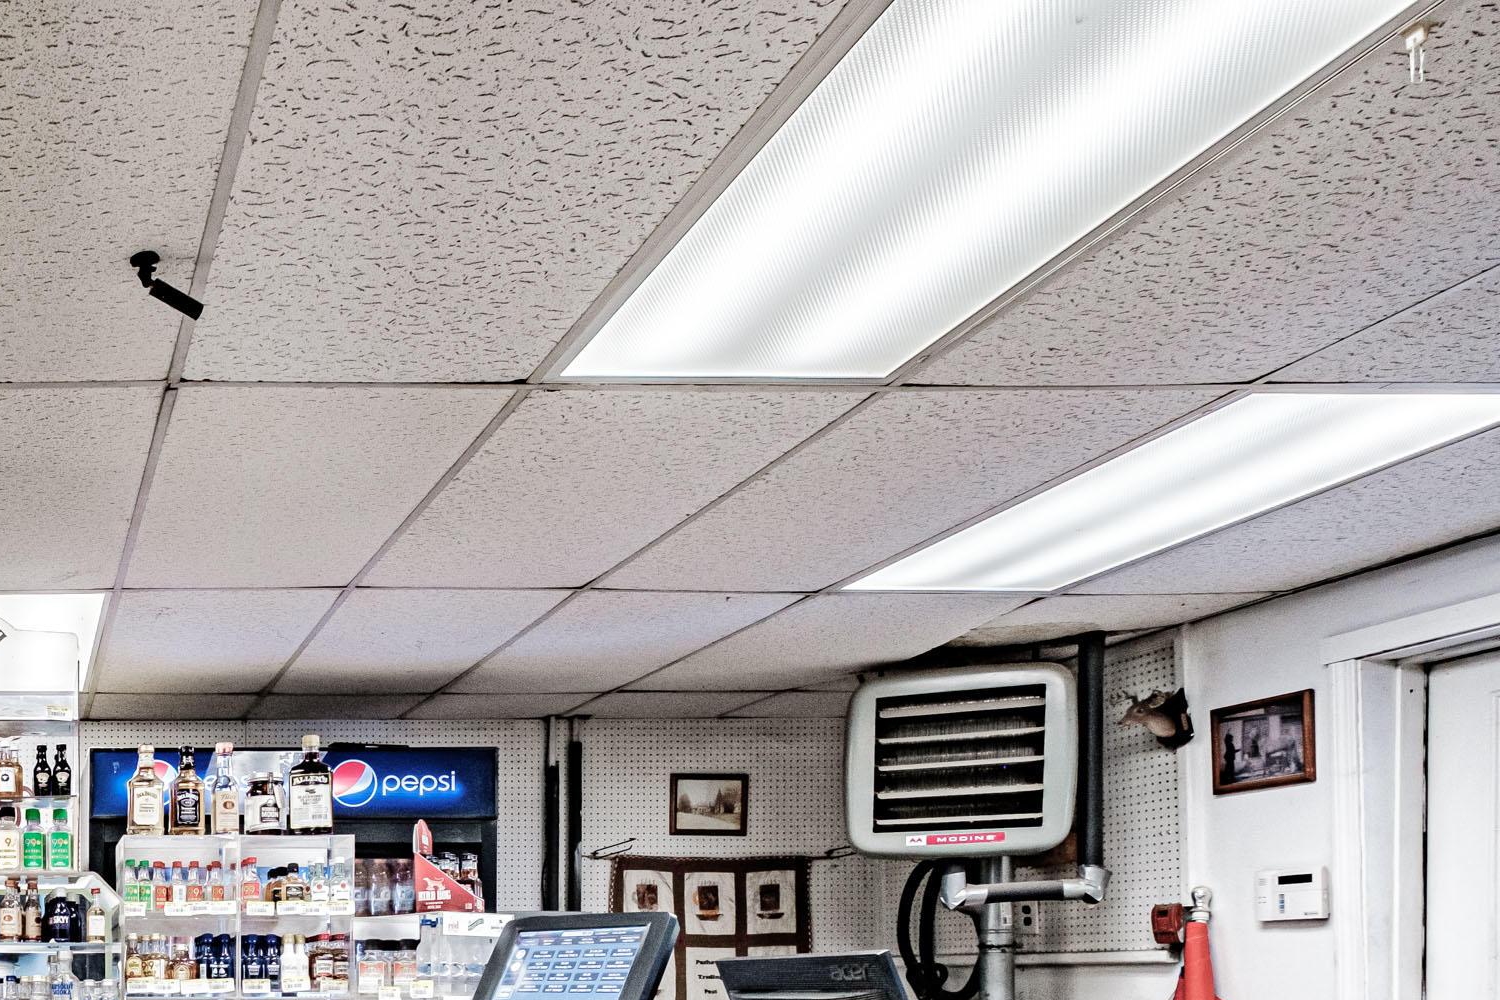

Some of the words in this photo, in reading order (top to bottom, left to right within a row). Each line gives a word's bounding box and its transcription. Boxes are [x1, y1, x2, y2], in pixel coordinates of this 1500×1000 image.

[293, 775, 328, 785] ALLEN'S
[381, 770, 456, 796] pepsi
[936, 835, 997, 843] MODINE
[831, 963, 870, 982] acer
